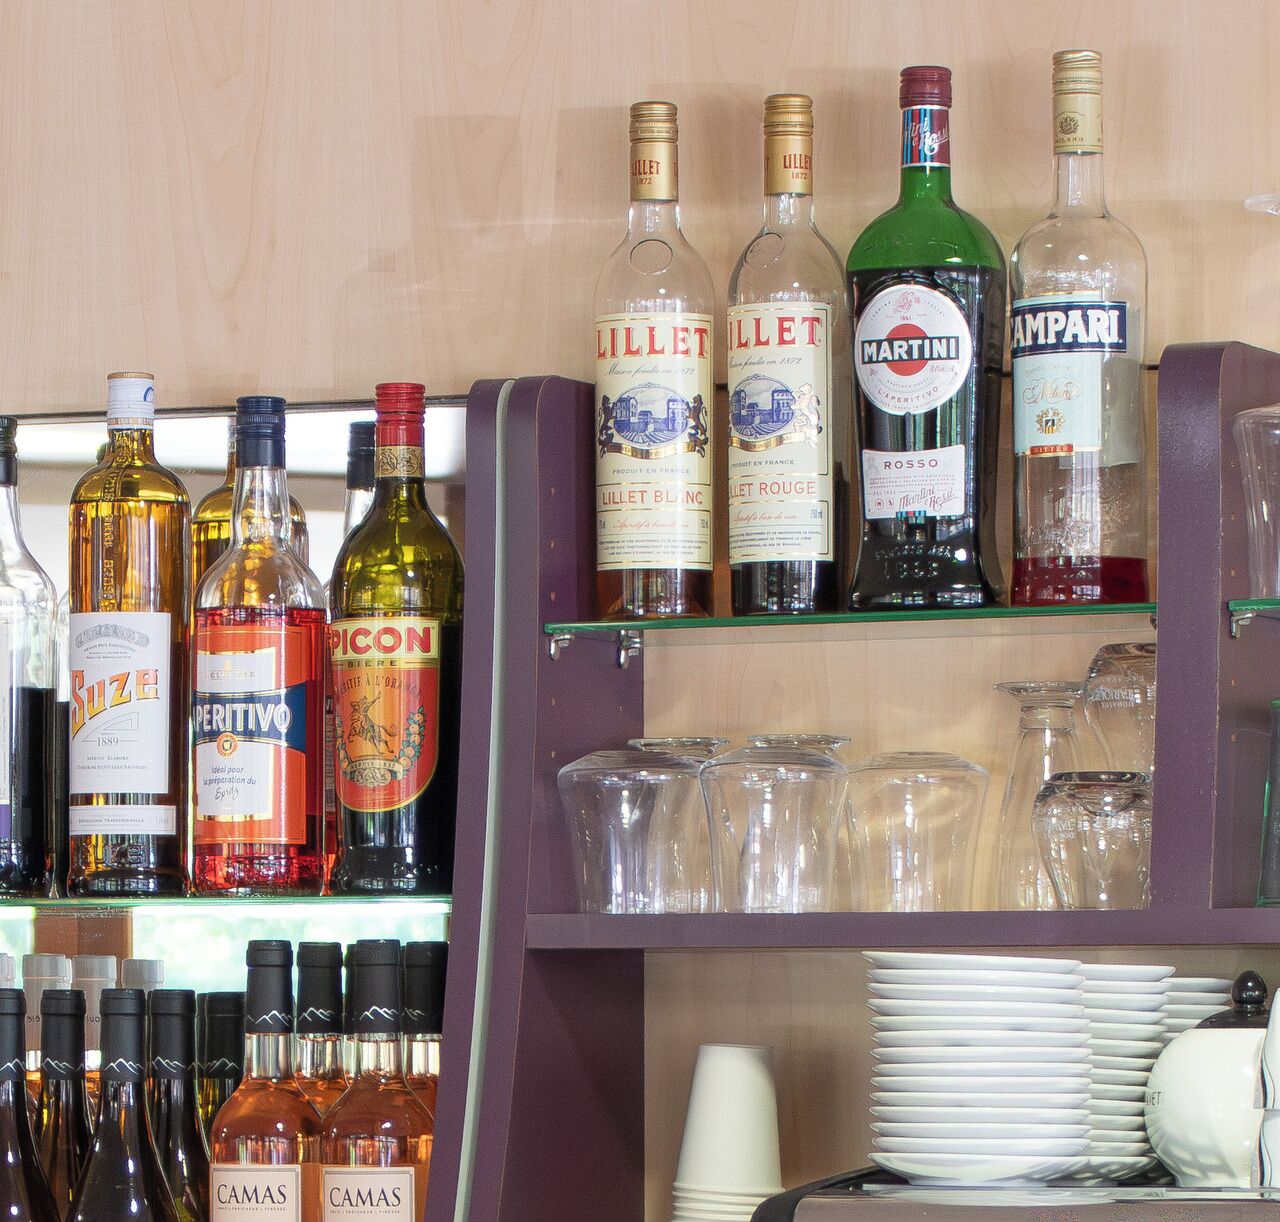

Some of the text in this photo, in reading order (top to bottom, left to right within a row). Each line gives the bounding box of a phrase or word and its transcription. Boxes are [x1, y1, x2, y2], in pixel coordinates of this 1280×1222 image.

[729, 317, 822, 350] ILLET
[1011, 309, 1122, 348] AMPARI
[597, 326, 708, 359] LILLET
[863, 338, 957, 361] MARTINI
[780, 357, 802, 365] 1872
[883, 458, 938, 470] ROSSO
[602, 490, 648, 505] LILLET
[759, 481, 817, 496] ROUGE
[331, 626, 432, 657] PICON
[71, 668, 160, 740] Suze
[96, 737, 119, 747] 1889
[208, 776, 257, 788] préparation du
[226, 766, 245, 777] pour
[217, 1183, 287, 1205] CAMAS
[329, 1186, 401, 1208] CAMAS
